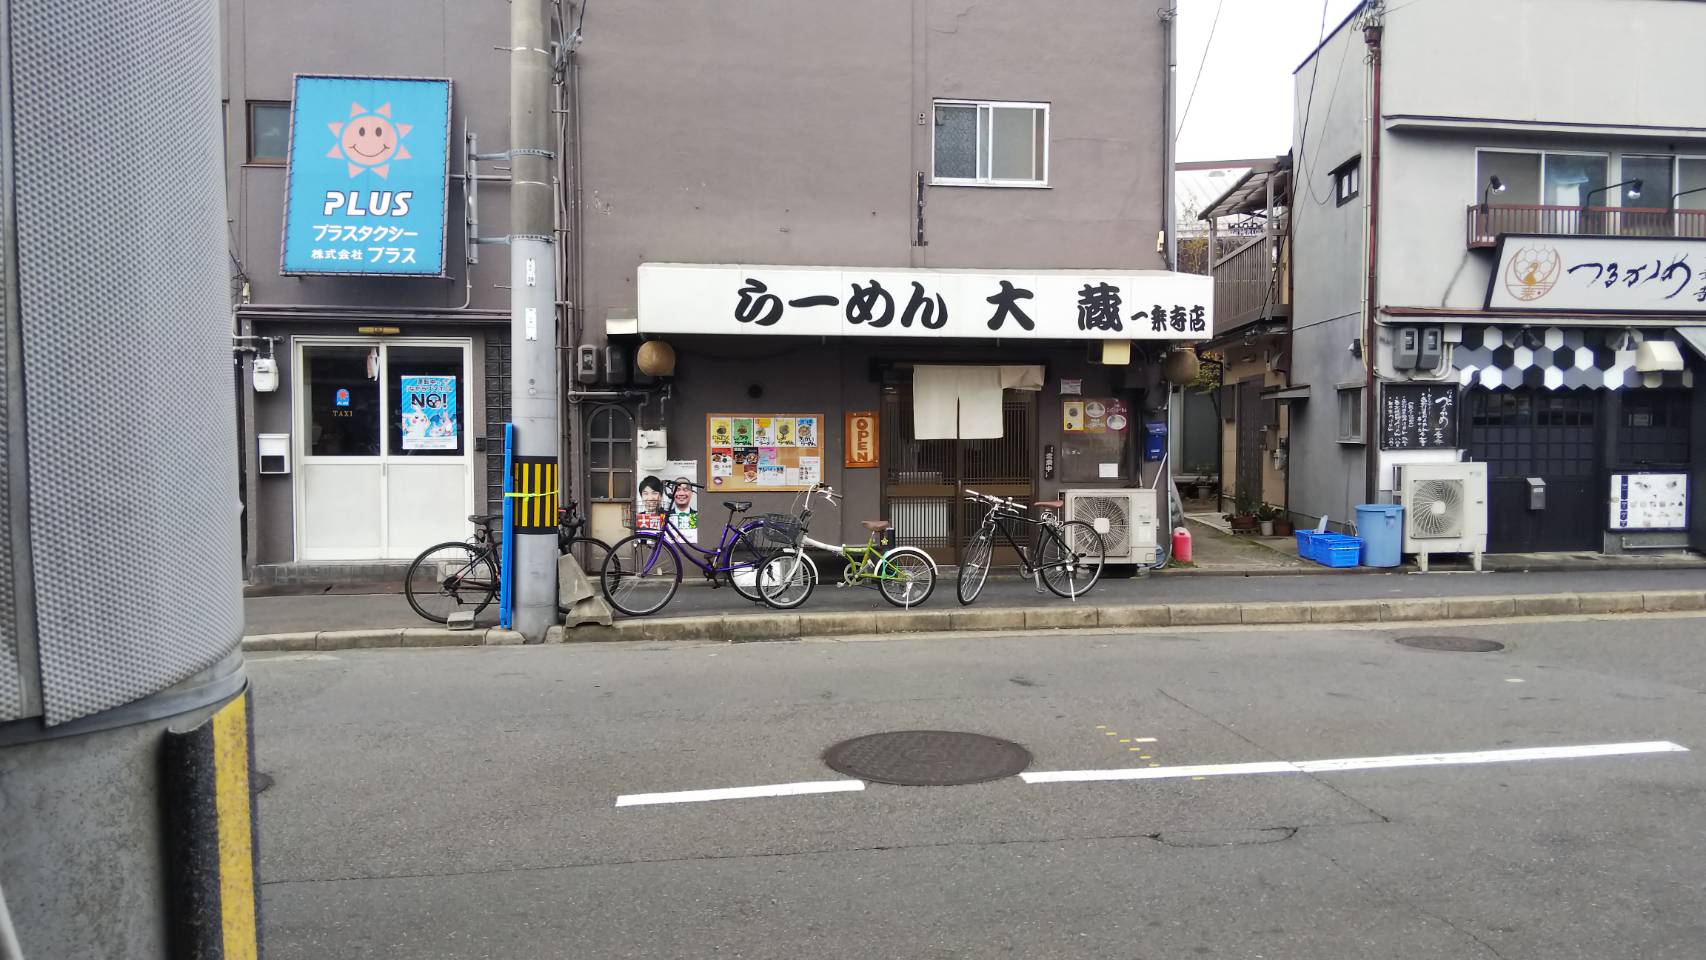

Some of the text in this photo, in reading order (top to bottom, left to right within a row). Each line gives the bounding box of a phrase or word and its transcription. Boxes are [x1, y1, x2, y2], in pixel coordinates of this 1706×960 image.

[324, 191, 412, 216] PLUS
[313, 224, 418, 242] プラスタクシー
[311, 247, 416, 264] 株式会社 プラス
[735, 279, 948, 330] らーめん
[1131, 304, 1206, 332] 一乗寺店
[857, 418, 869, 462] OPEN
